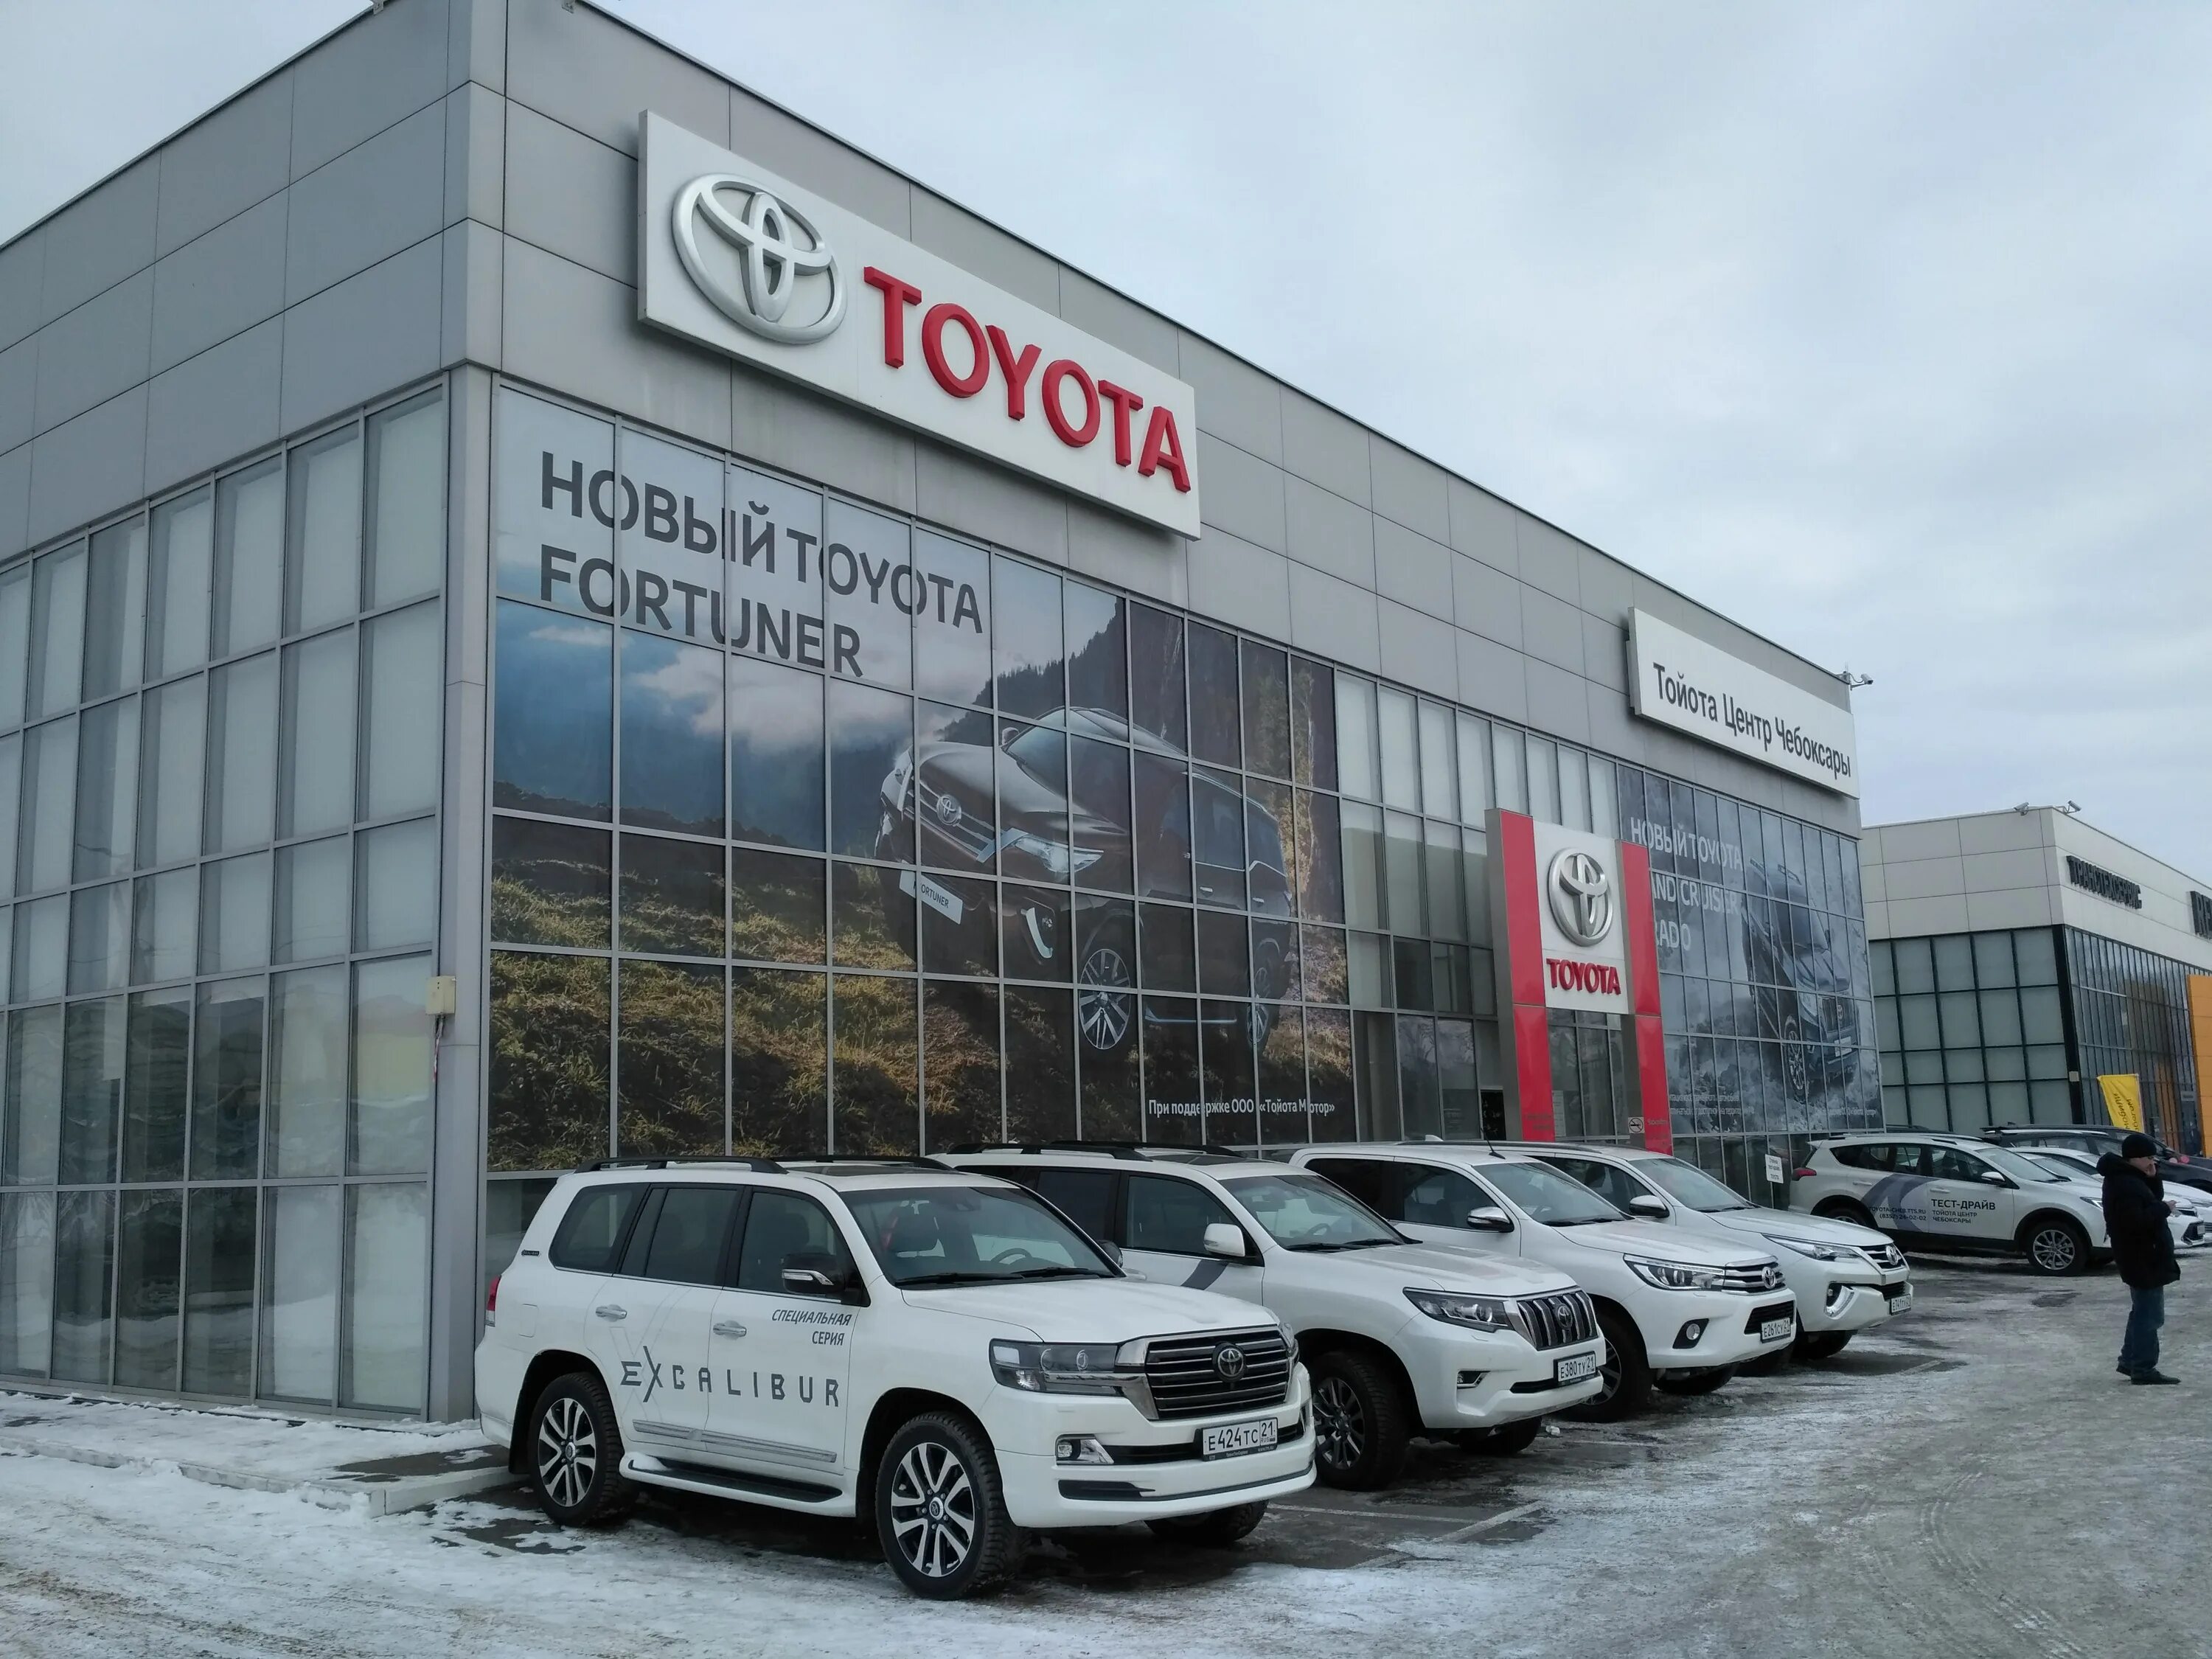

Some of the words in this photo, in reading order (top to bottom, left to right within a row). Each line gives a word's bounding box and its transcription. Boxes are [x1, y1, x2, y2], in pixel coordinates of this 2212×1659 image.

[864, 266, 1191, 493] TOYOTA
[542, 451, 775, 574] НОВЫЙ
[786, 528, 982, 633] TOYOTA
[540, 543, 863, 678] FORTUNER
[1653, 662, 1718, 722] Тойота
[1722, 692, 1772, 751] Центр
[1775, 716, 1851, 779] Чебоксары
[1631, 817, 1687, 858] НОВЫЙ
[1688, 833, 1743, 872] TOYOTA
[914, 880, 949, 908] ORTUNER
[1680, 879, 1742, 916] CRUISER
[1656, 919, 1691, 951] ADO
[1546, 959, 1621, 995] TOYOTA
[1149, 1099, 1170, 1118] При
[1172, 1101, 1230, 1116] поддержке
[1231, 1099, 1253, 1113] ООО
[1259, 1099, 1298, 1113] «Тойота
[1931, 1199, 1995, 1210] ТЕСТ-ДРАЙВ
[771, 1310, 852, 1326] СПЕЦИАЛЬНАЯ
[812, 1331, 845, 1346] СЕРИЯ
[620, 1346, 839, 1407] EXCALIBUR
